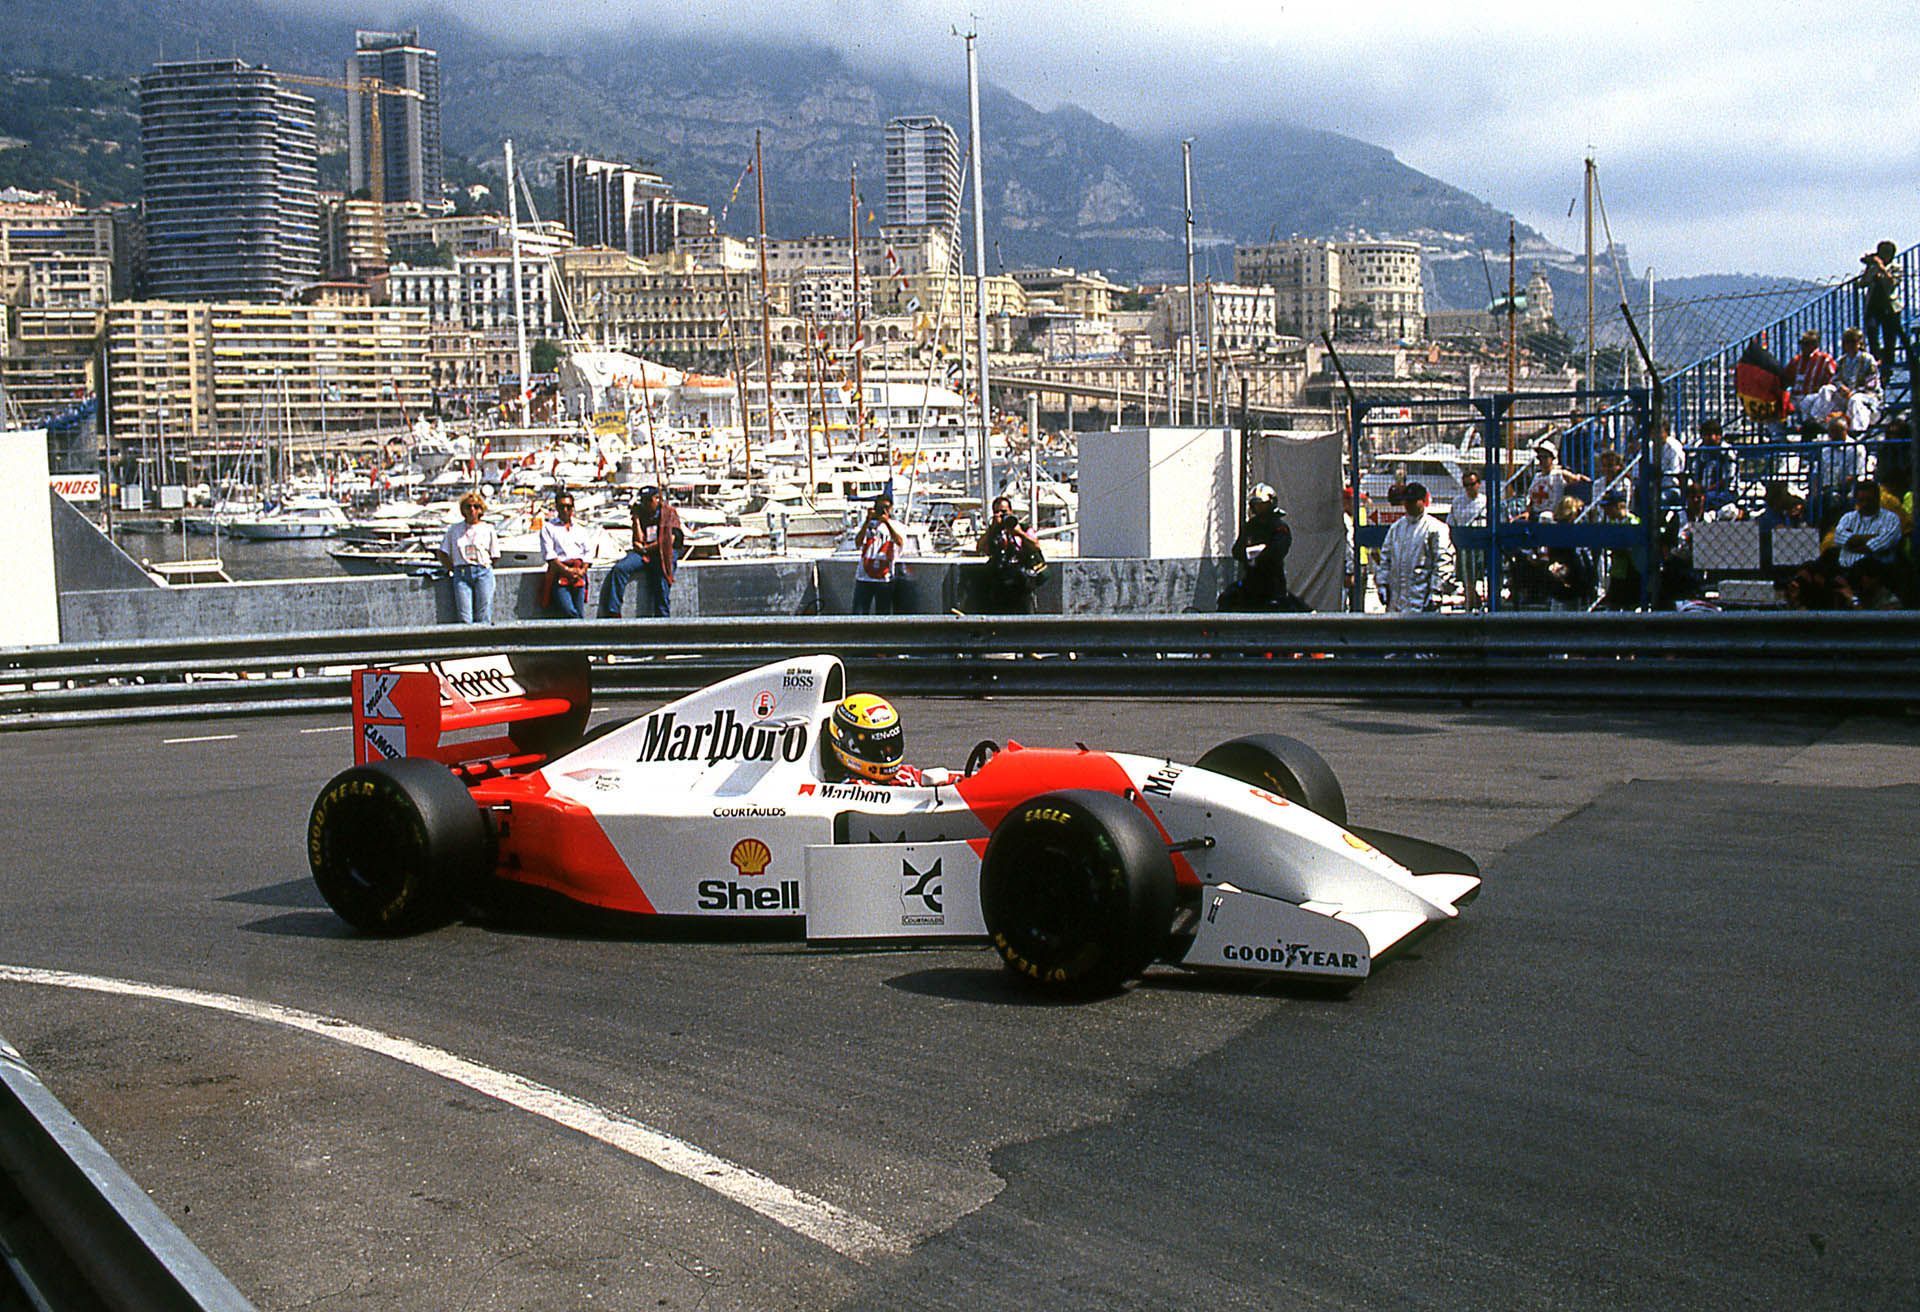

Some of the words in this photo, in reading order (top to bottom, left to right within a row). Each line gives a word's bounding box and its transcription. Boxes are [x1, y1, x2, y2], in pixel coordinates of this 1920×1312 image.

[50, 480, 99, 494] ONDES
[783, 676, 814, 687] BOSS
[365, 724, 402, 759] CAMOZ
[636, 709, 808, 767] Marlboro
[820, 785, 891, 804] Marlboro
[713, 807, 786, 817] COURTAULDS
[1025, 808, 1072, 824] EAGLE
[698, 880, 800, 910] Shell
